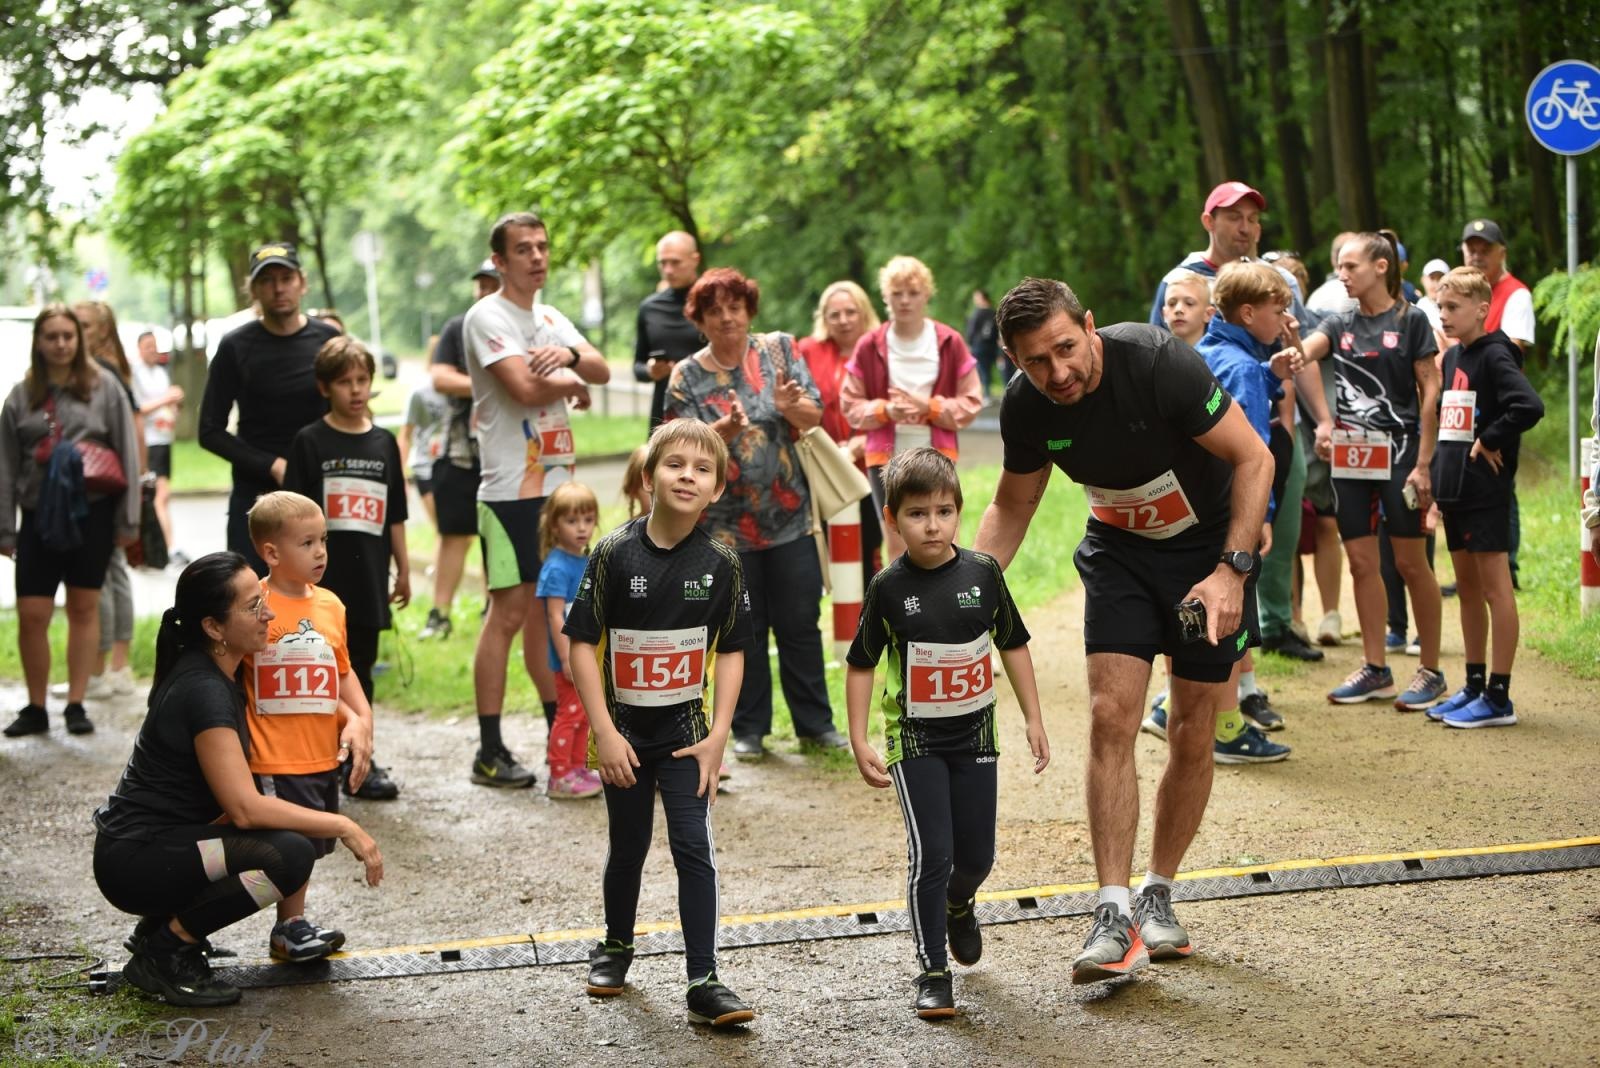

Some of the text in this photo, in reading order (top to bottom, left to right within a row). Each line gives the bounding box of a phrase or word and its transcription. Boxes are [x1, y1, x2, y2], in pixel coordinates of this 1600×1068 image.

[554, 431, 571, 453] 40
[1347, 446, 1373, 467] 87
[1148, 480, 1174, 497] 4500 M
[337, 495, 378, 521] 143
[1115, 505, 1165, 528] 72
[684, 589, 710, 597] MORE
[959, 598, 980, 606] MORE
[617, 634, 634, 644] Bieg
[680, 638, 697, 646] 4500
[915, 648, 932, 657] Bieg
[272, 667, 330, 696] 112
[630, 655, 691, 688] 154
[927, 662, 985, 700] 153
